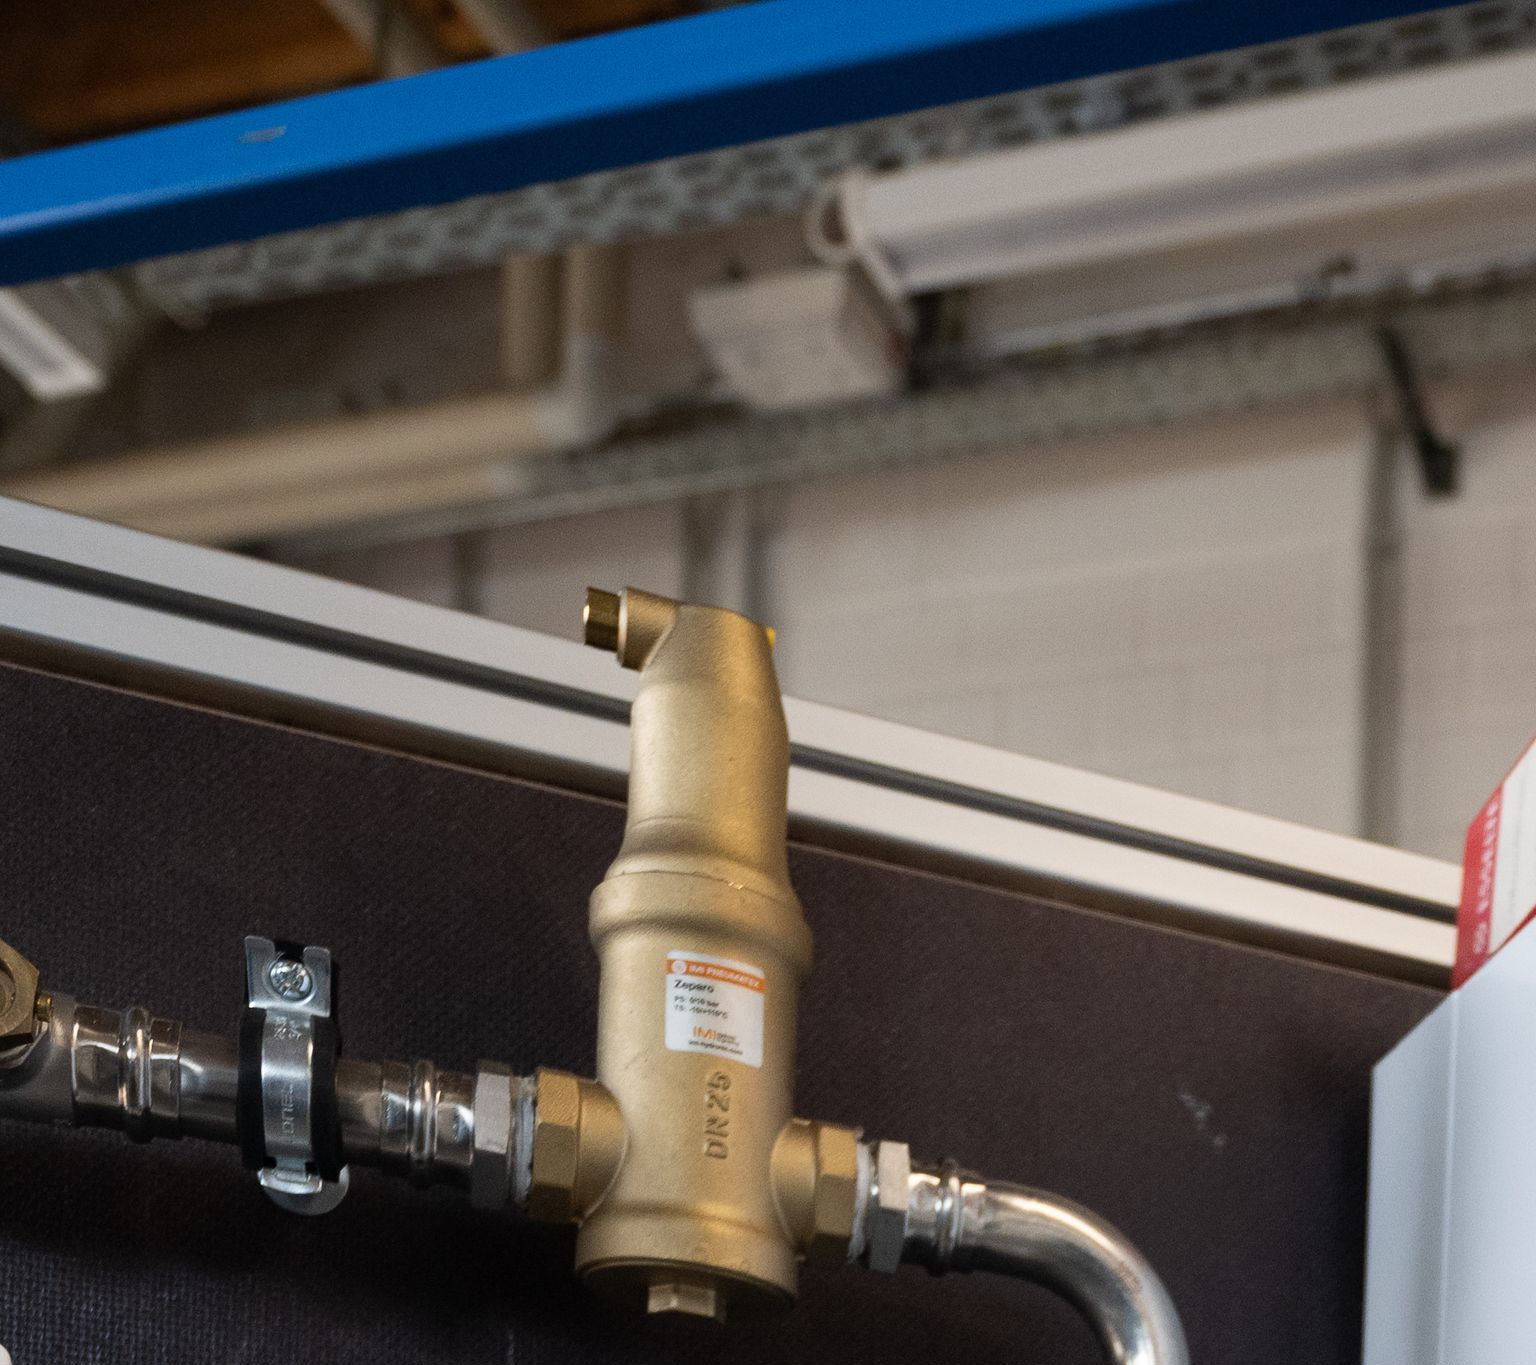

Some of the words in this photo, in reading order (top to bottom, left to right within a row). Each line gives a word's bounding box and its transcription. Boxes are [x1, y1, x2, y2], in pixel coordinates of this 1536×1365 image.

[674, 978, 715, 993] Zeparo
[704, 1071, 732, 1112] 25
[703, 1117, 730, 1160] DN
